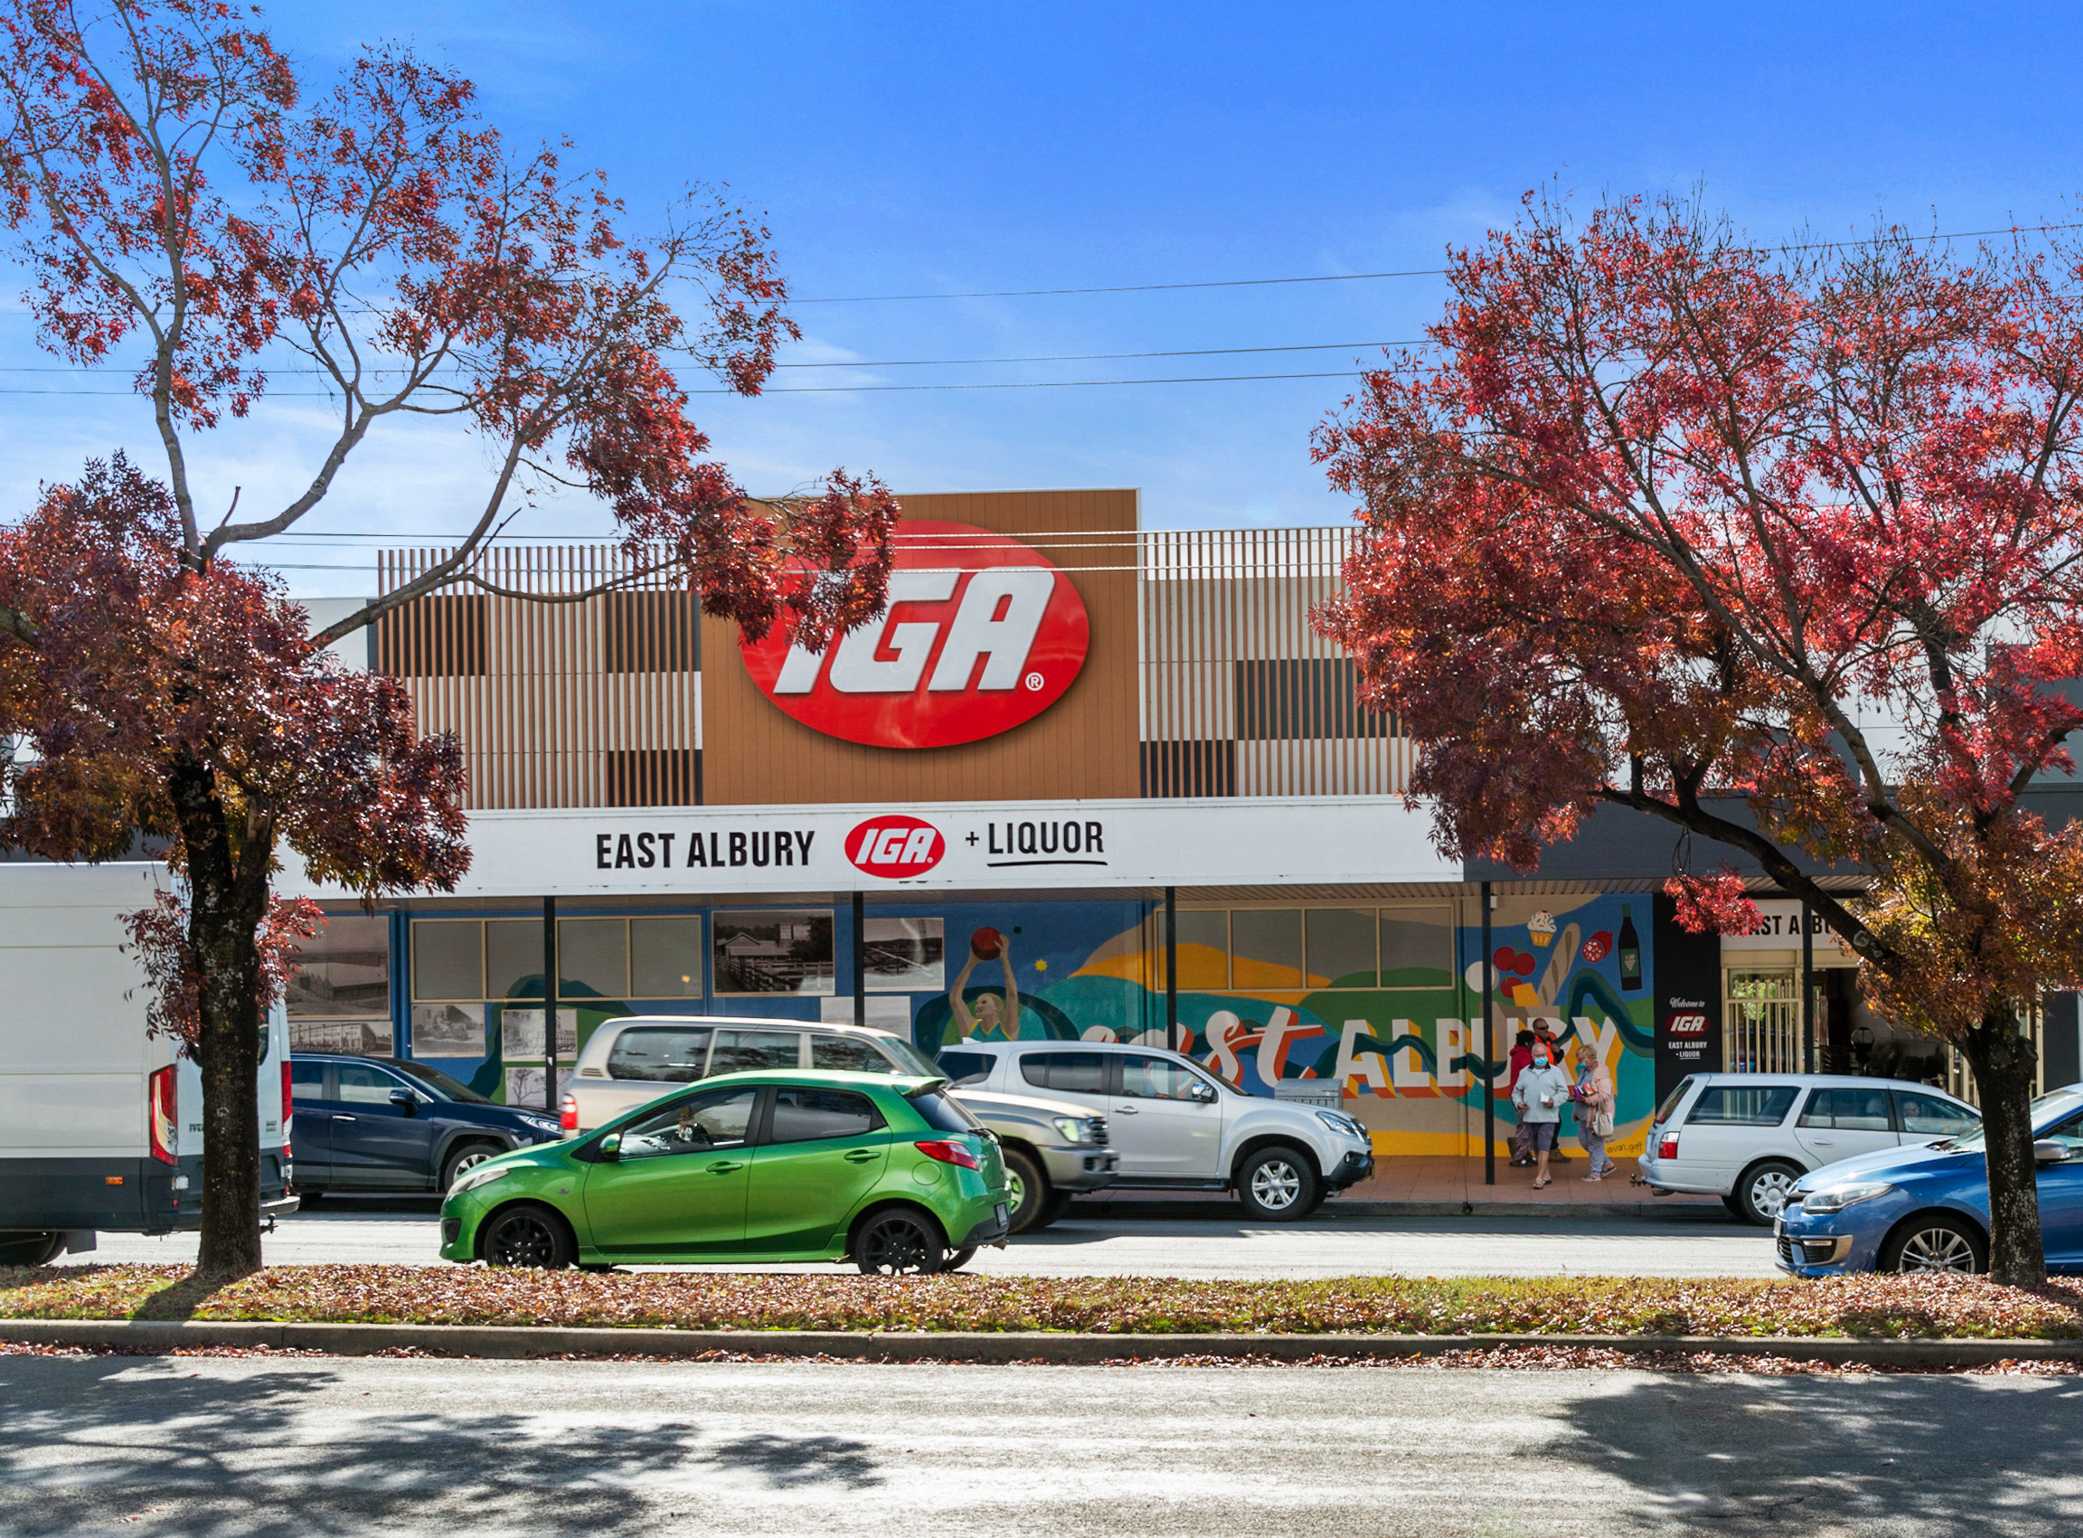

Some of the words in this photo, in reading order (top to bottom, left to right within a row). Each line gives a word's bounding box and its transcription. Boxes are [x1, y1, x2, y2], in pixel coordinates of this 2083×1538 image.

[773, 566, 1056, 694] IGA
[596, 832, 675, 869] EAST
[686, 830, 815, 868] ALBURY
[855, 827, 938, 864] IGA
[988, 821, 1104, 854] LIQUOR
[1748, 915, 1782, 935] ST
[1670, 1015, 1705, 1032] IGA
[1668, 1041, 1683, 1049] EAST
[1684, 1041, 1707, 1049] ALBURY
